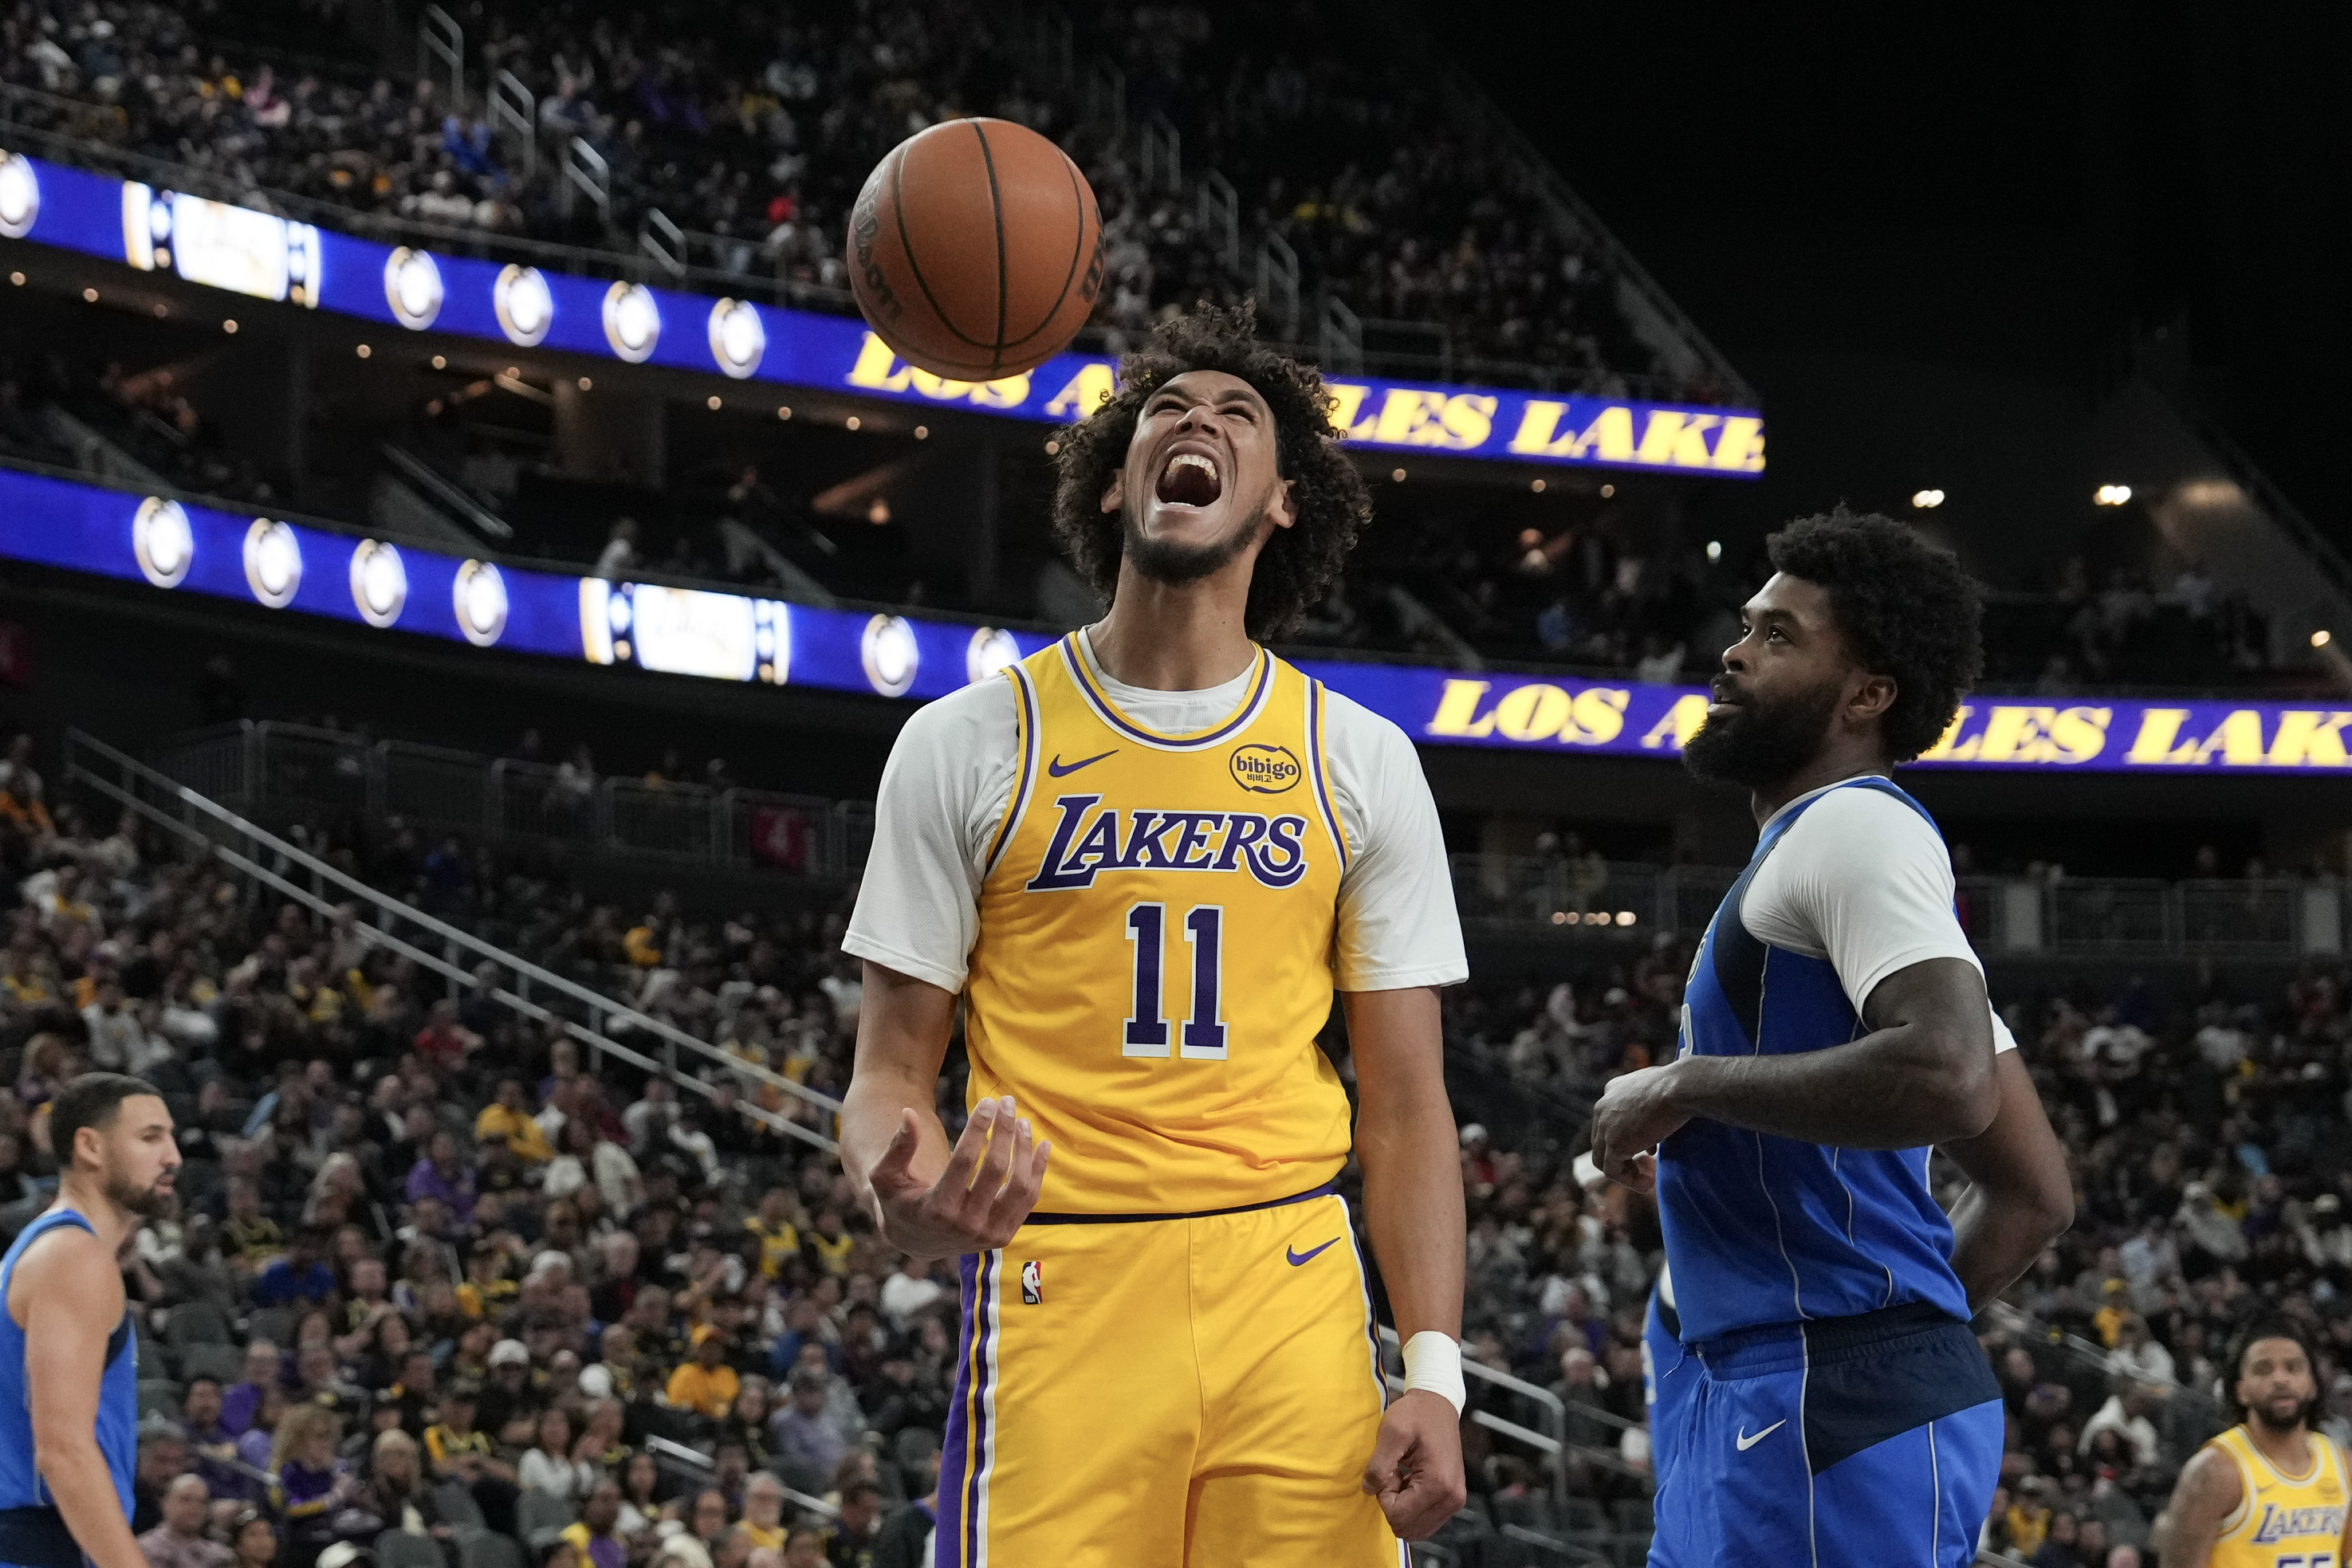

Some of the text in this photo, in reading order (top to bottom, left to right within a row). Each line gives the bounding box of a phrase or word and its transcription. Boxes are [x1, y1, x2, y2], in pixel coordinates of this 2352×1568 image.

[1506, 399, 1765, 472] LAKE
[1426, 678, 2352, 767] LOS ALES LAK
[1236, 756, 1297, 780] bibigo
[1247, 773, 1272, 783] 비비고
[1025, 793, 1309, 892] LAKERS
[1122, 902, 1228, 1060] 11
[1025, 1295, 1036, 1303] NBA
